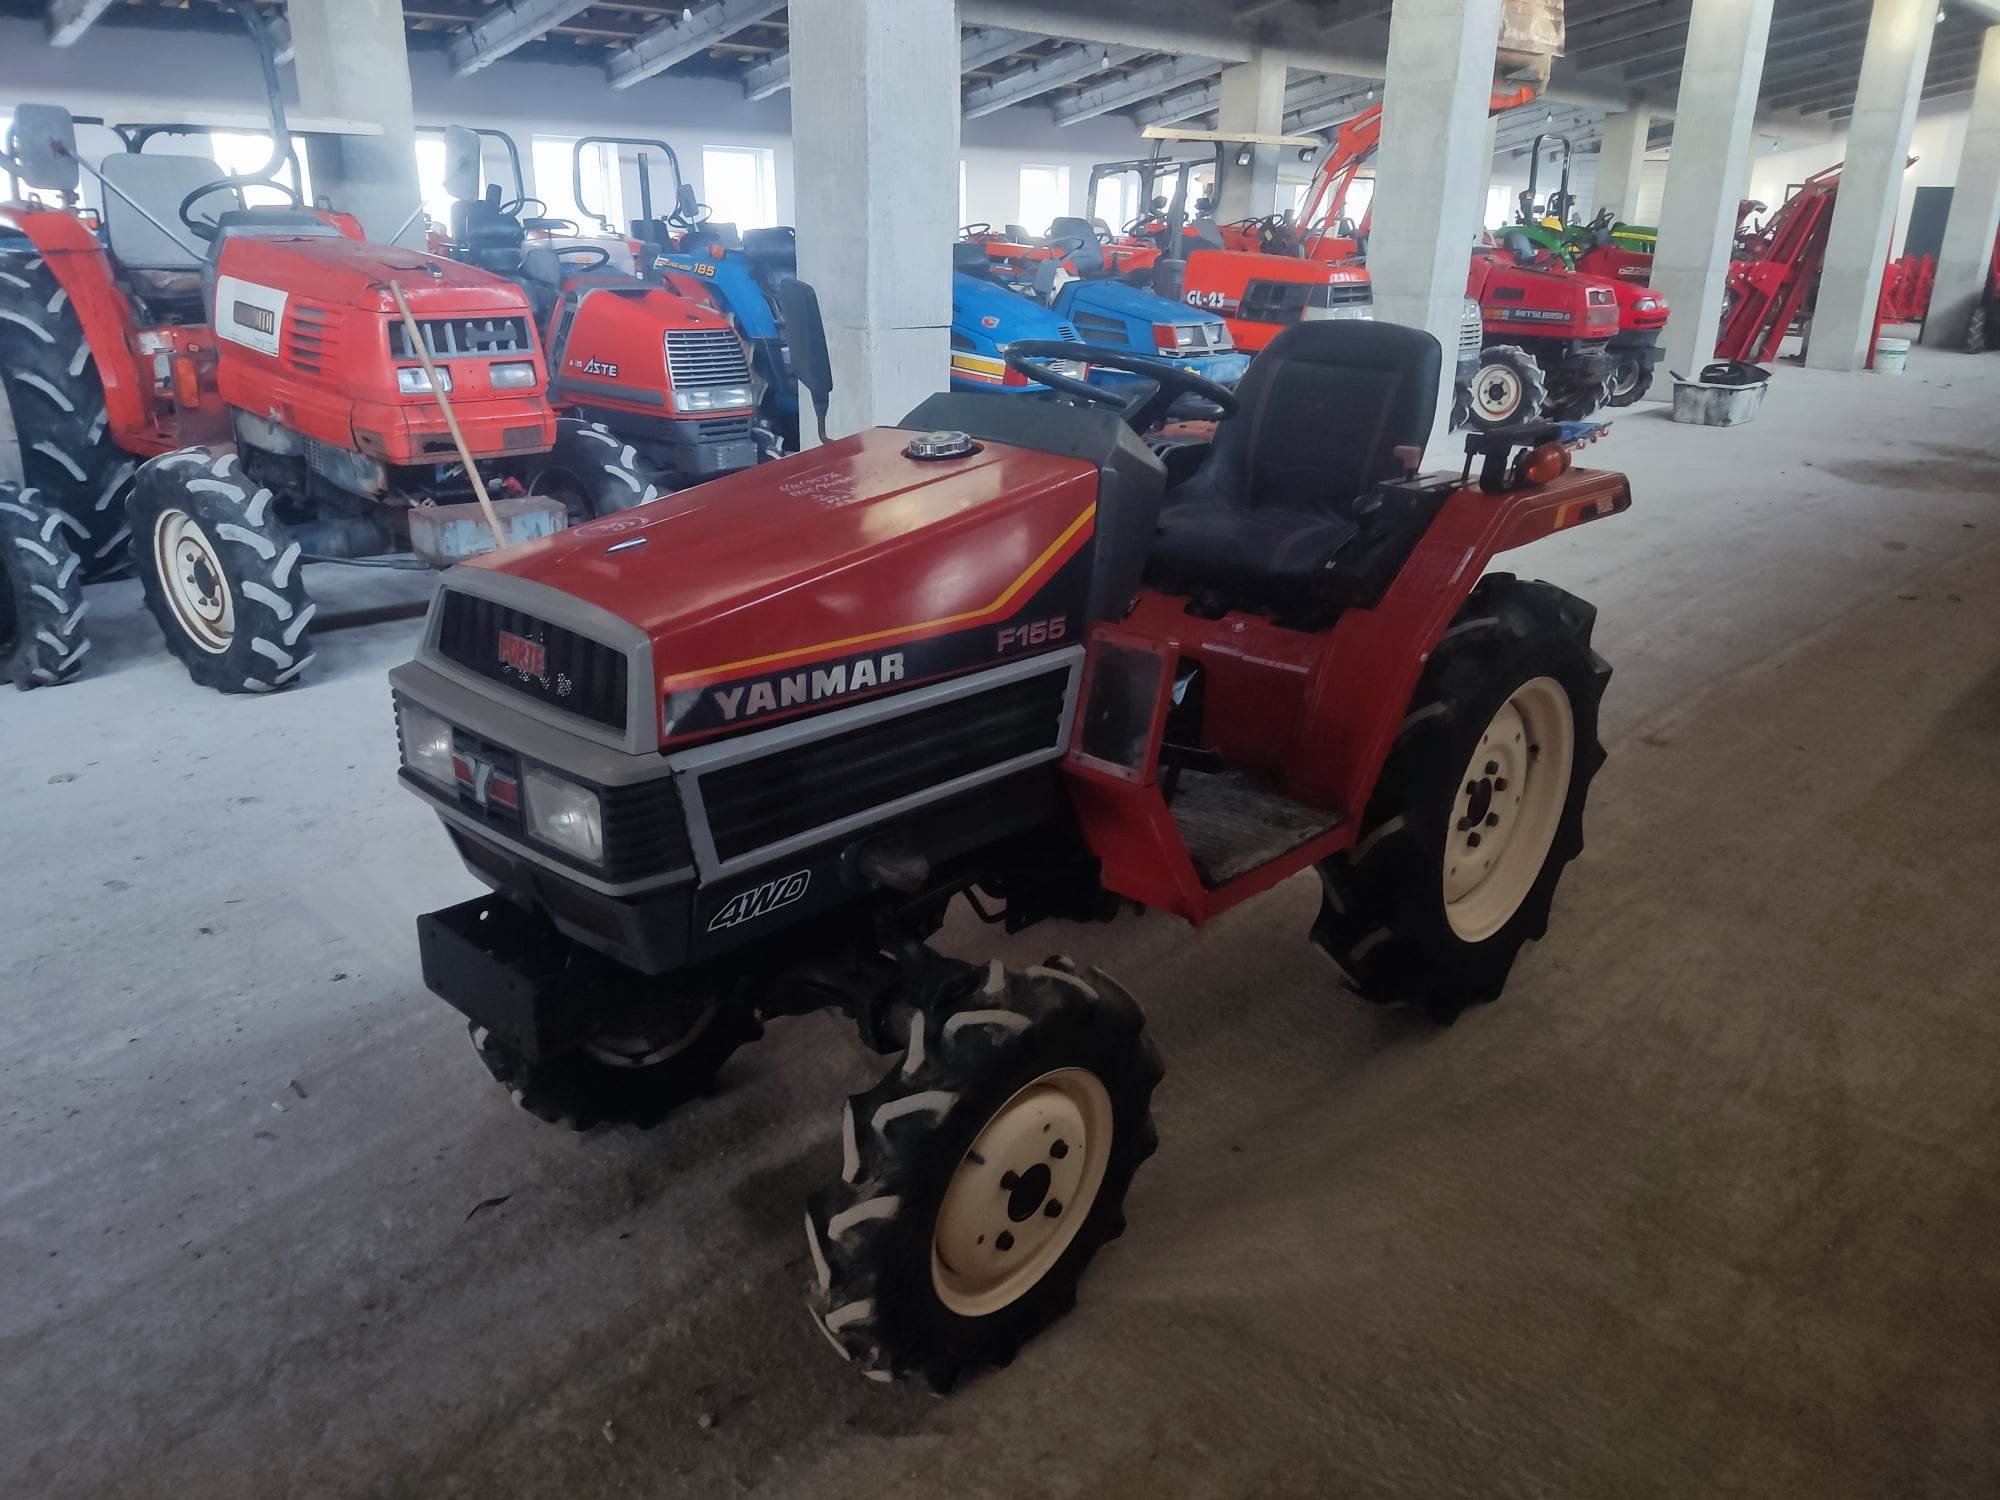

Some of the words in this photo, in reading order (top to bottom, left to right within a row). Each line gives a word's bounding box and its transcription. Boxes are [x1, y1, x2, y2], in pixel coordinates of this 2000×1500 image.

[583, 357, 618, 377] ASTE
[997, 616, 1066, 652] F155
[713, 652, 905, 720] YANMAR
[707, 868, 811, 932] 4WD
